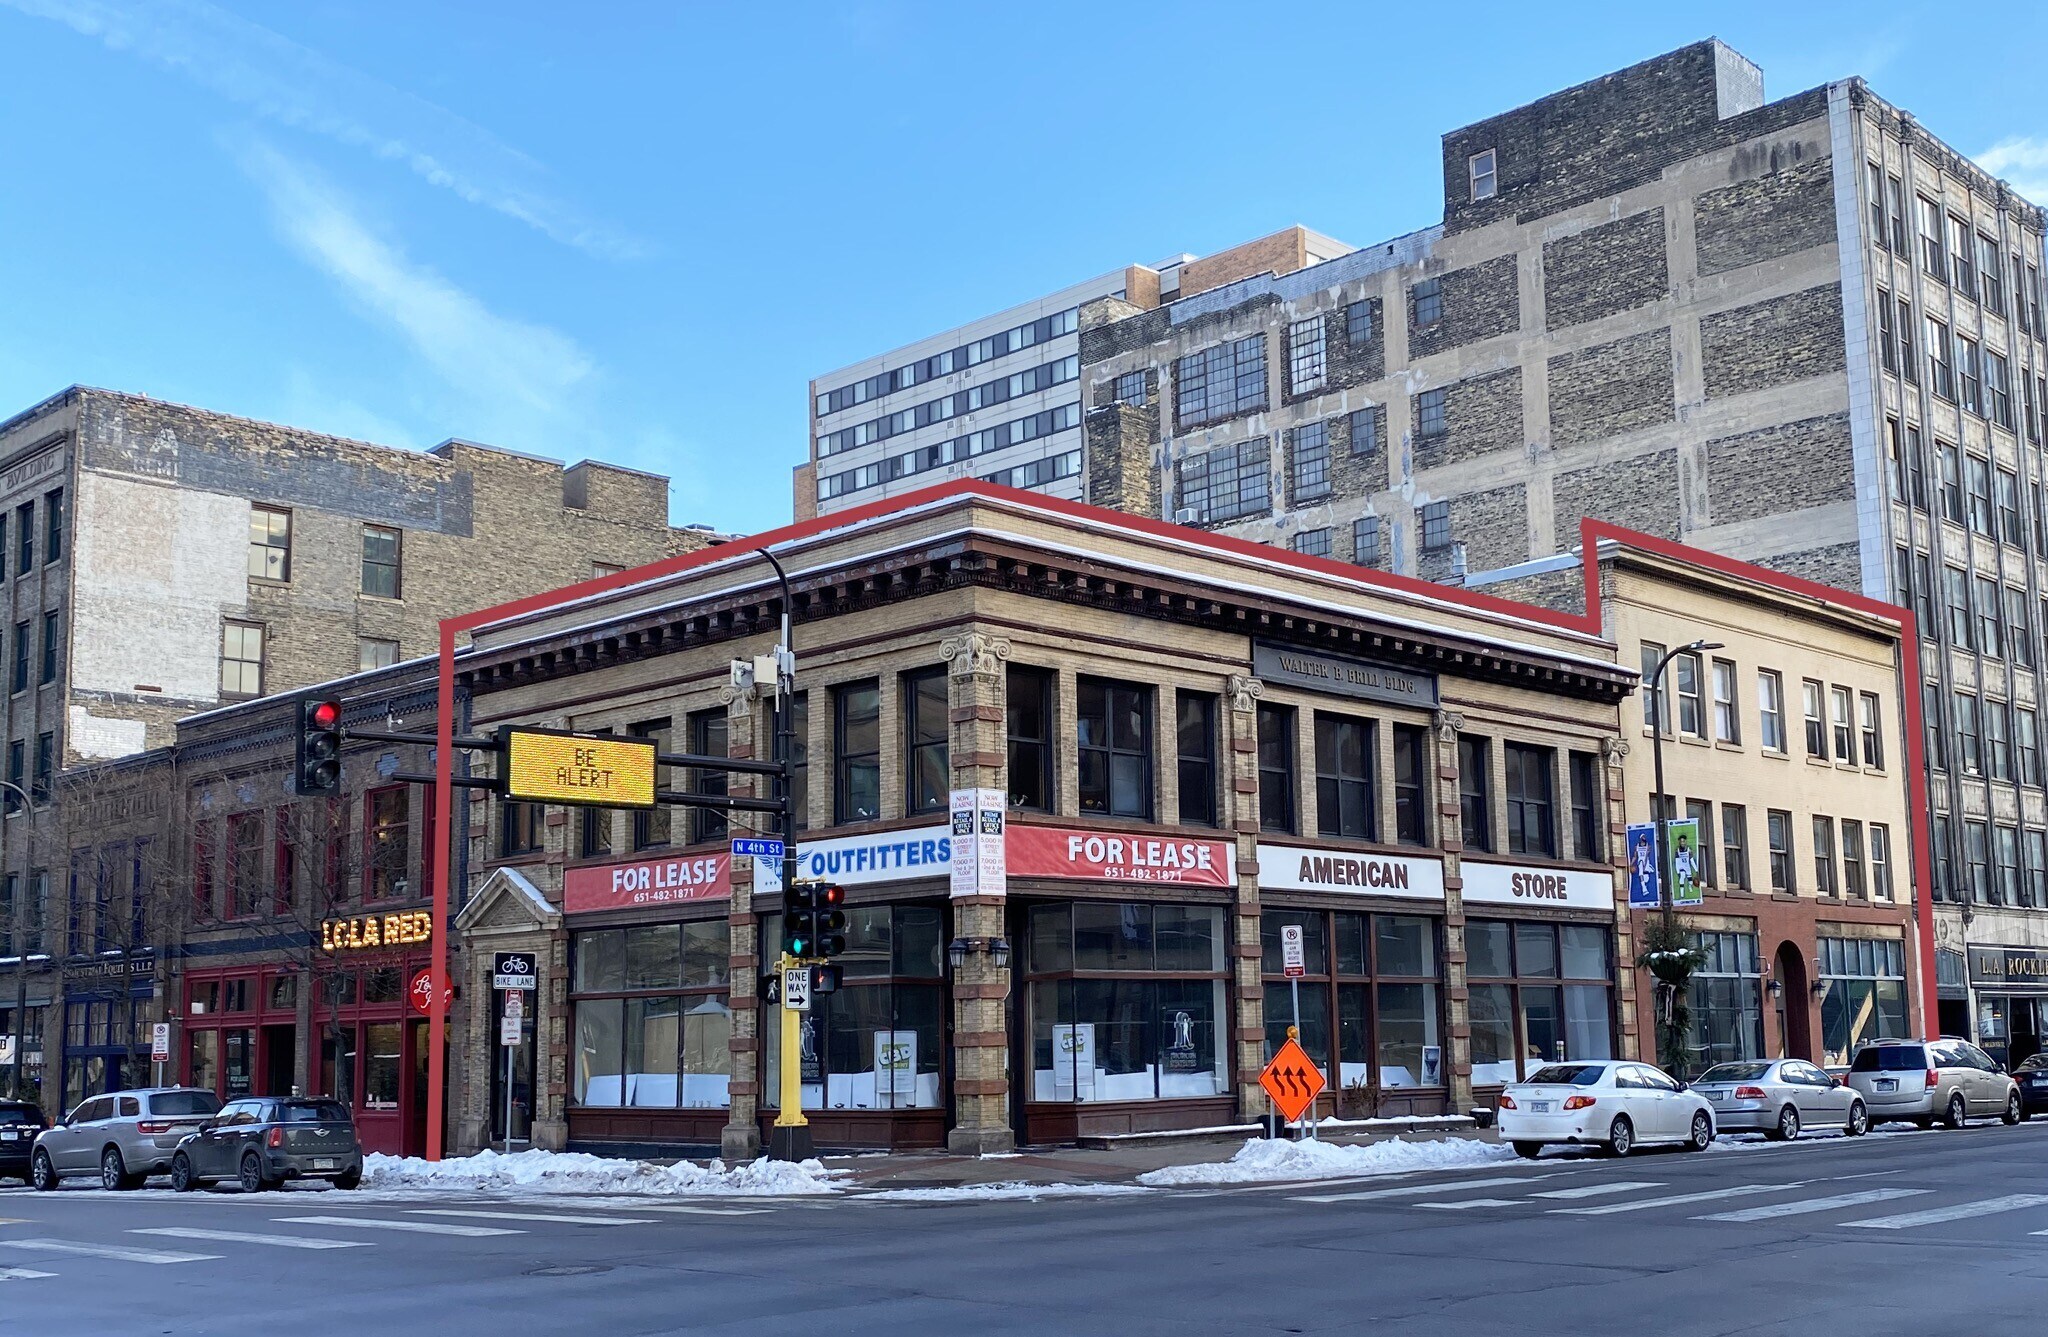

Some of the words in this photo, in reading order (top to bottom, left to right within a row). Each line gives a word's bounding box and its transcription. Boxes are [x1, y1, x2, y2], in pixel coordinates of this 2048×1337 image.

[1279, 656, 1329, 679] WALTER
[1334, 666, 1344, 681] B.
[1347, 669, 1380, 688] BRILL
[1385, 676, 1417, 694] BLDG.
[575, 748, 597, 767] BE
[557, 767, 613, 788] ALERT
[980, 801, 1003, 809] LEASING
[736, 842, 744, 852] N
[748, 842, 765, 853] 4th
[769, 843, 780, 854] St
[811, 837, 951, 876] OUTFITTERS
[1068, 836, 1124, 865] FOR
[1131, 840, 1212, 870] LEASE
[612, 865, 651, 893] FOR
[655, 859, 716, 888] LEASE
[1104, 867, 1182, 881] 651-482-1871
[1299, 856, 1408, 889] AMERICAN
[634, 888, 694, 902] 651-482-1871
[1512, 872, 1567, 900] STORE
[384, 911, 432, 945] RED
[104, 962, 134, 976] EQUITS
[1981, 957, 2003, 975] L.A.
[496, 977, 511, 986] BIKE
[516, 977, 533, 986] LANE
[788, 972, 807, 981] ONE
[788, 983, 807, 992] WAY
